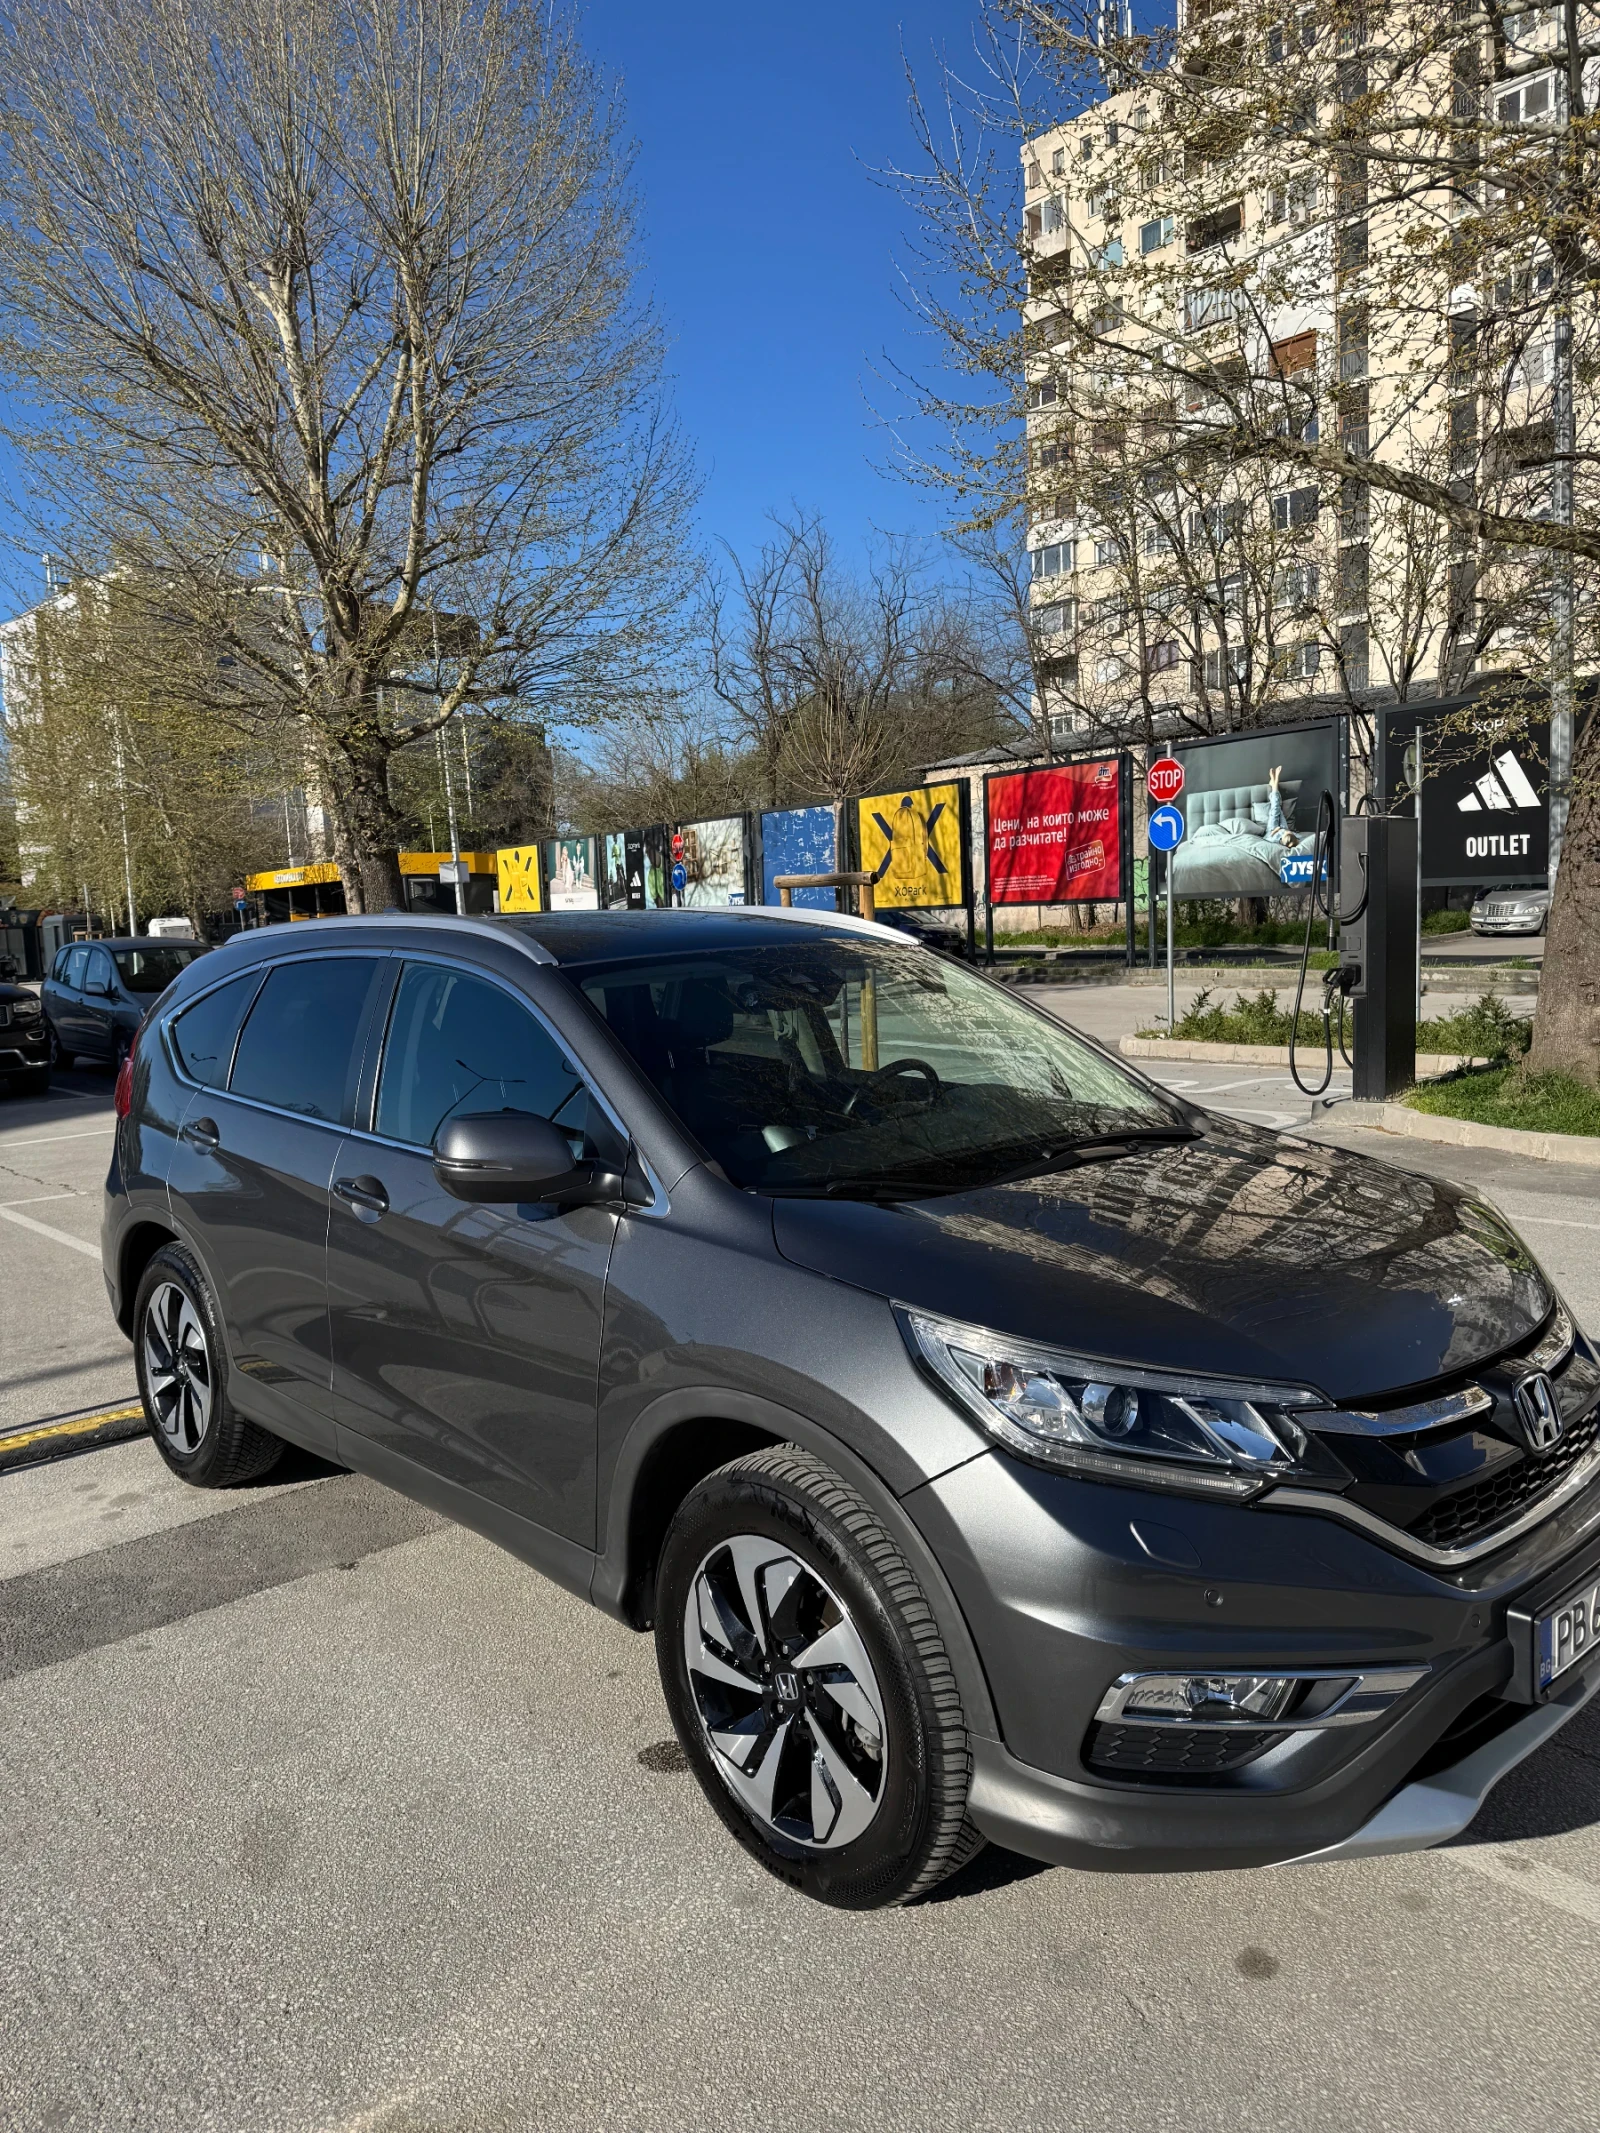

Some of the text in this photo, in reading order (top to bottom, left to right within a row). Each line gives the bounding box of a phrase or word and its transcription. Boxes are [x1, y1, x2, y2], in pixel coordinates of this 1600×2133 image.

[1151, 768, 1181, 790] STOP
[993, 808, 1109, 834] Цени, на които може
[993, 828, 1067, 851] да разчитате!
[1466, 834, 1530, 857] OUTLET
[1540, 1658, 1551, 1679] BG
